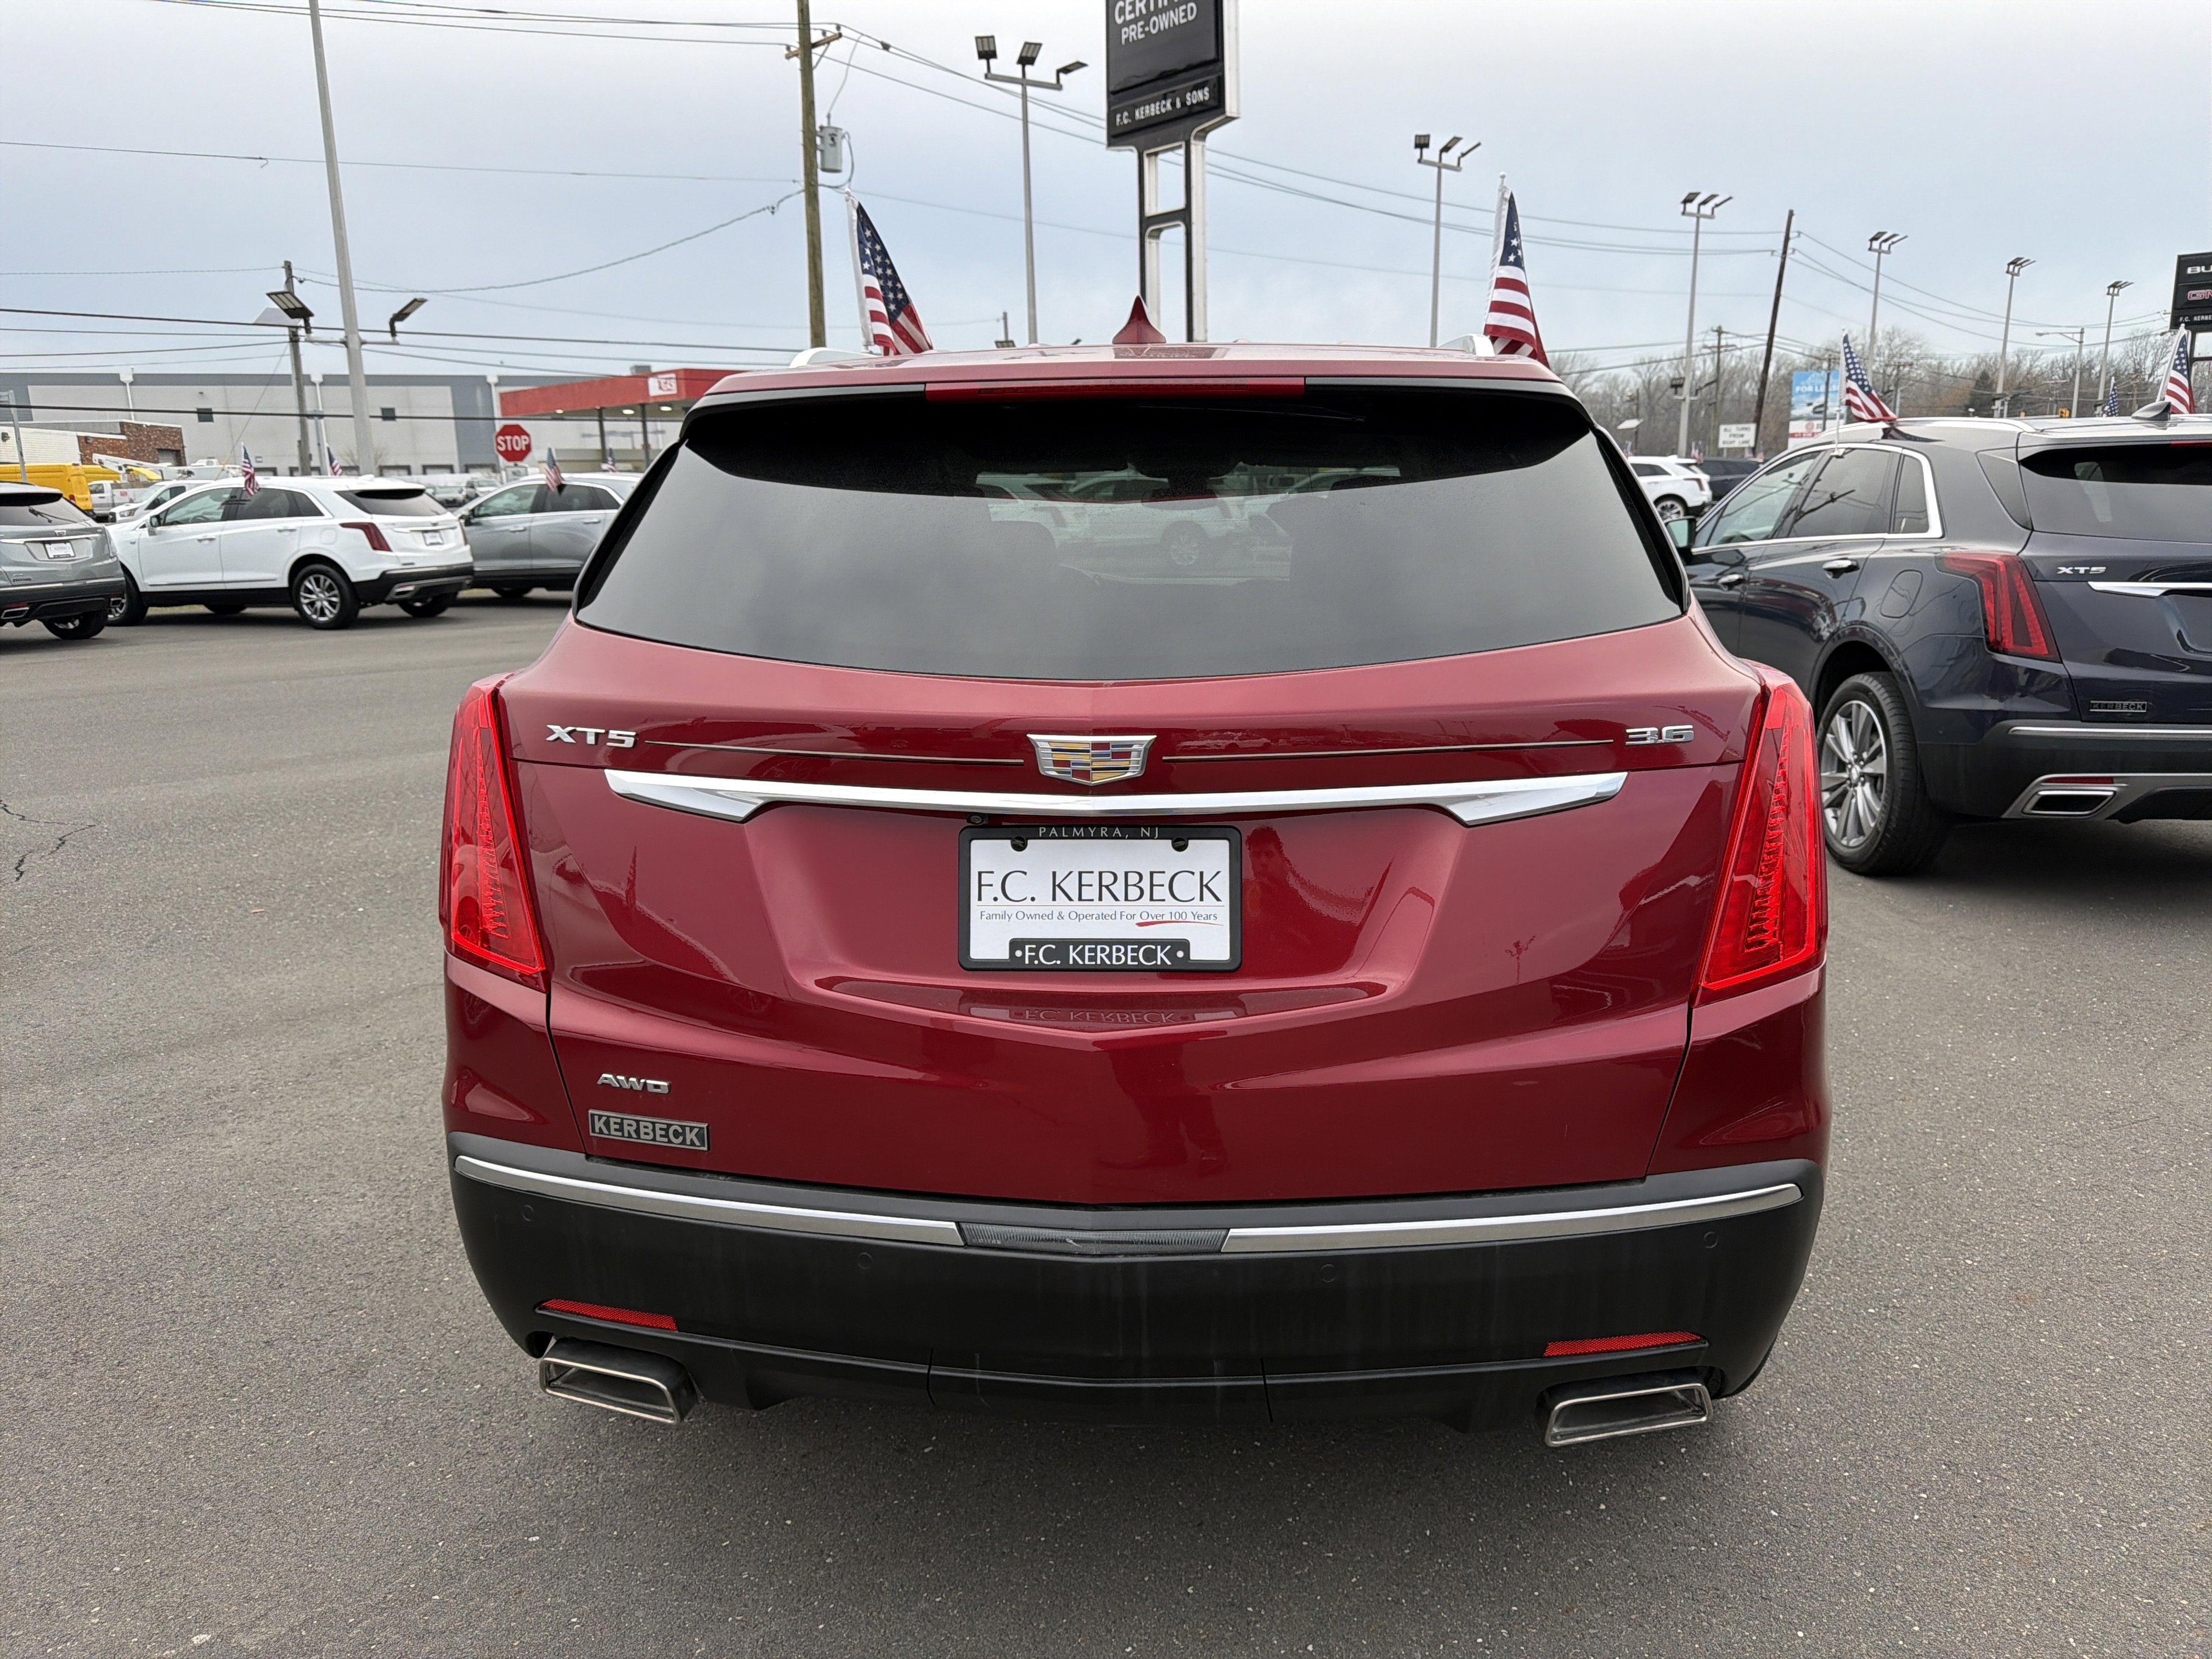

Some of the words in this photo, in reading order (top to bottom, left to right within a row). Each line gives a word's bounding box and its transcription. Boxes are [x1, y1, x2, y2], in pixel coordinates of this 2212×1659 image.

[1121, 2, 1197, 45] PRE-OWNED
[1116, 111, 1132, 126] F.C.
[1135, 99, 1172, 121] KERBECK
[1176, 97, 1181, 109] &
[1186, 87, 1210, 106] SONS
[497, 435, 529, 451] STOP
[545, 724, 637, 748] XT5
[1039, 827, 1129, 839] PALMYRA,
[1141, 827, 1159, 839] NJ
[977, 870, 1036, 902] F.C.
[1052, 870, 1222, 902] KERBECK
[980, 911, 1013, 922] Family
[1015, 911, 1054, 921] Owned
[1057, 911, 1065, 921] &
[1068, 911, 1116, 922] Operated
[1120, 911, 1136, 921] For
[1139, 911, 1165, 921] Over
[1169, 911, 1187, 921] 100
[1191, 911, 1218, 921] Years
[1025, 945, 1060, 965] F.C.
[1069, 945, 1172, 965] KERBECK
[597, 1073, 669, 1094] AWD
[594, 1115, 701, 1147] KERBECK
